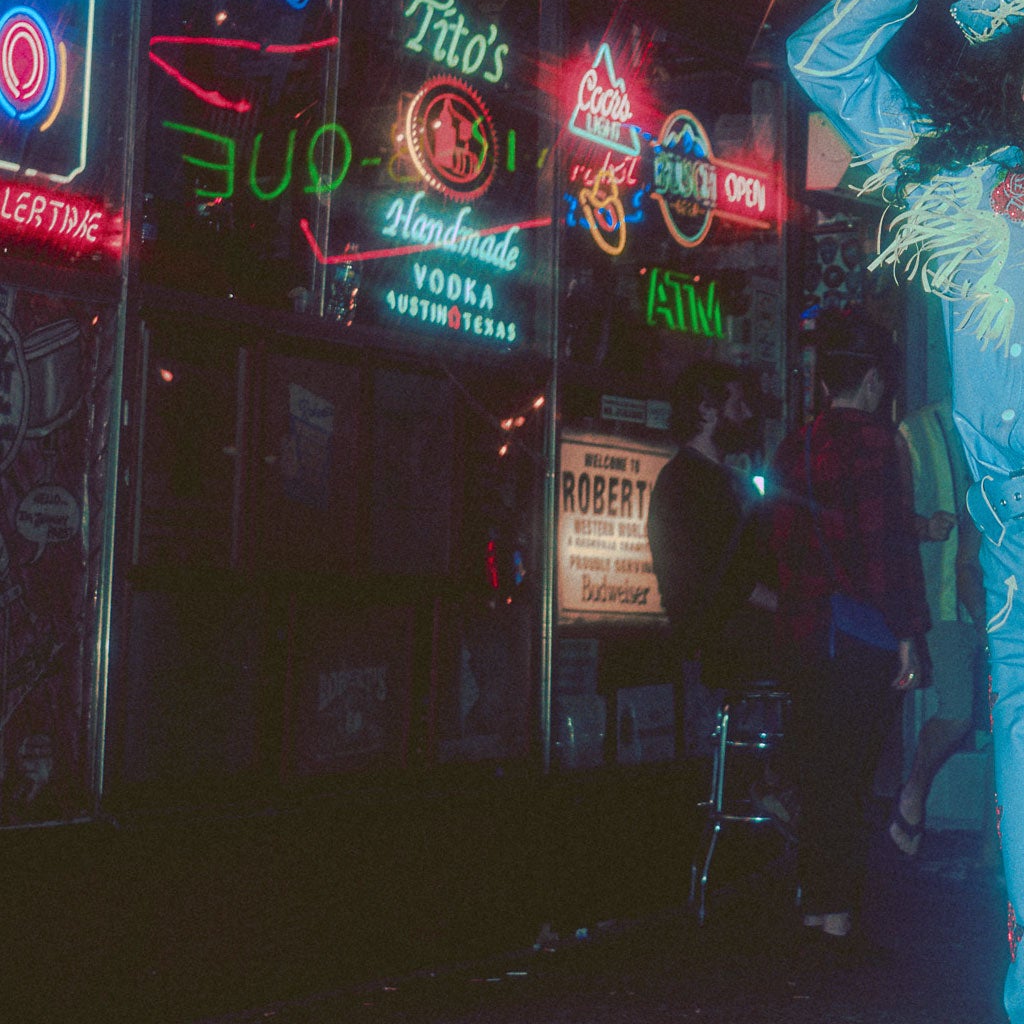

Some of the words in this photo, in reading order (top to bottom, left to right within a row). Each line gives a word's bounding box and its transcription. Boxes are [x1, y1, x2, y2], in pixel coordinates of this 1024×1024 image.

[578, 68, 633, 120] Coors
[724, 173, 767, 213] OPEN
[381, 190, 520, 272] Handmade
[413, 262, 493, 311] VODKA
[647, 267, 726, 339] ATM
[461, 310, 517, 343] TEXAS
[584, 453, 627, 472] WELCOME
